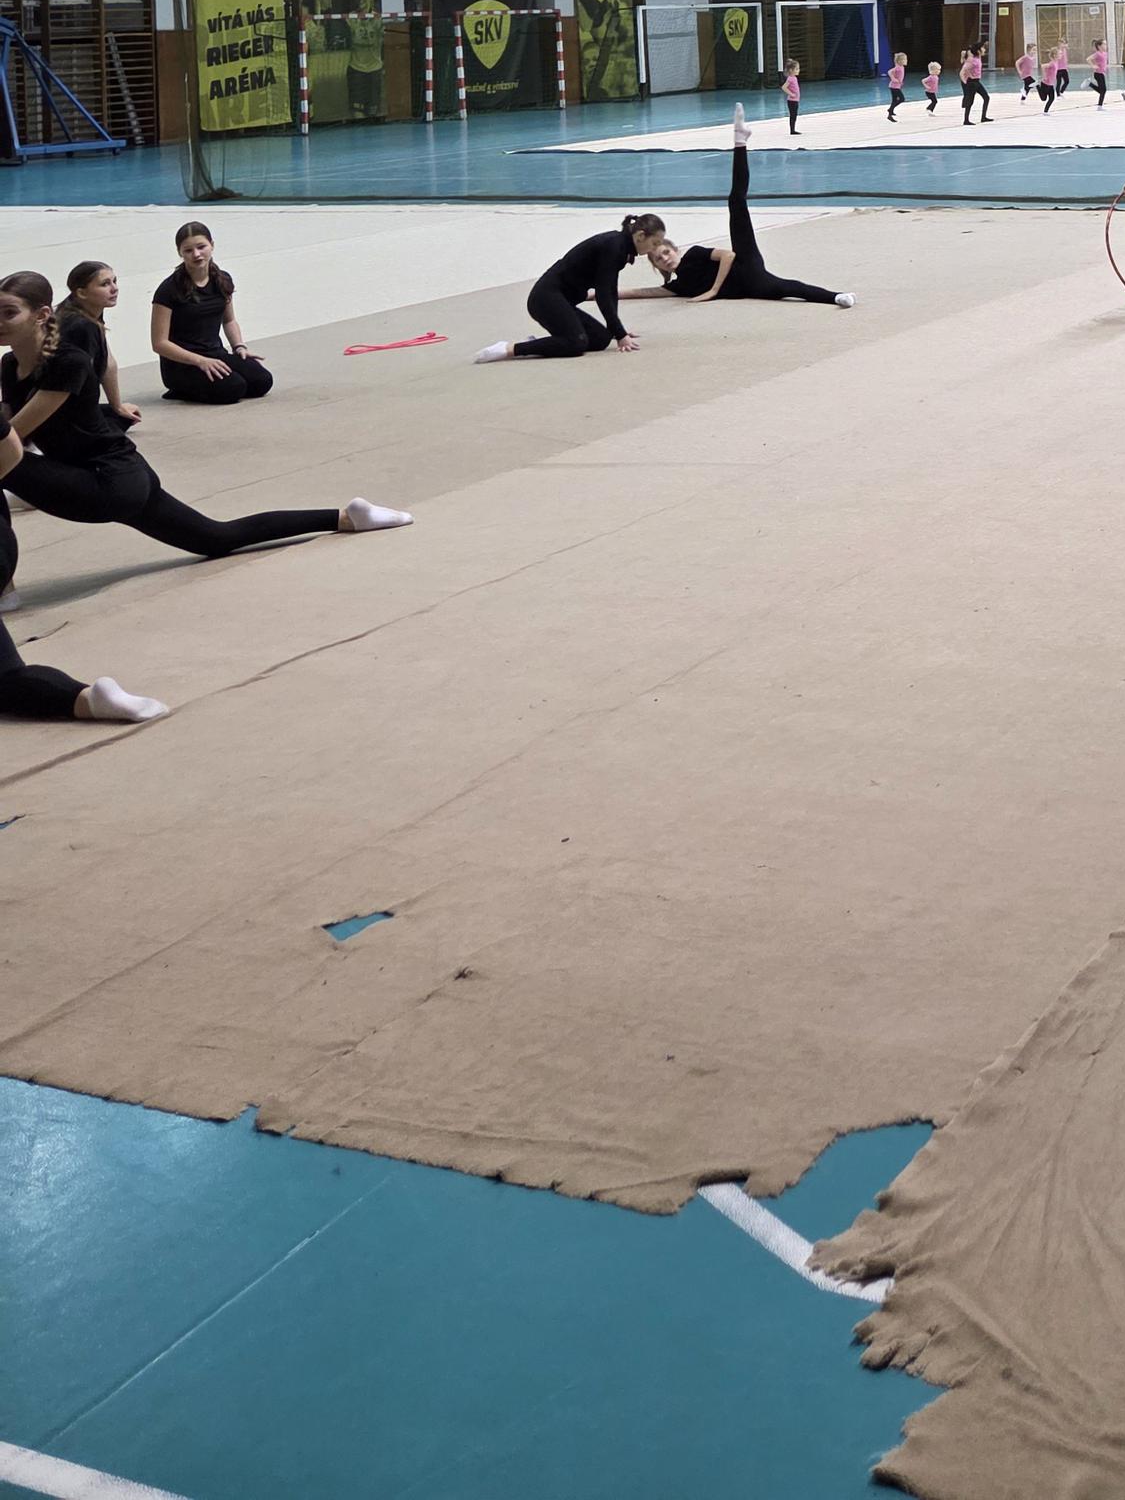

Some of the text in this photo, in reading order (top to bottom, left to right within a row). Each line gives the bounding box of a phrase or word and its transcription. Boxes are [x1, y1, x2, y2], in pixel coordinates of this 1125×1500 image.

[207, 4, 275, 34] VÍTÁ VÁS
[474, 15, 504, 45] SKV
[728, 17, 744, 36] SKV
[206, 35, 274, 67] RIEGER
[209, 67, 276, 100] ARÉNA
